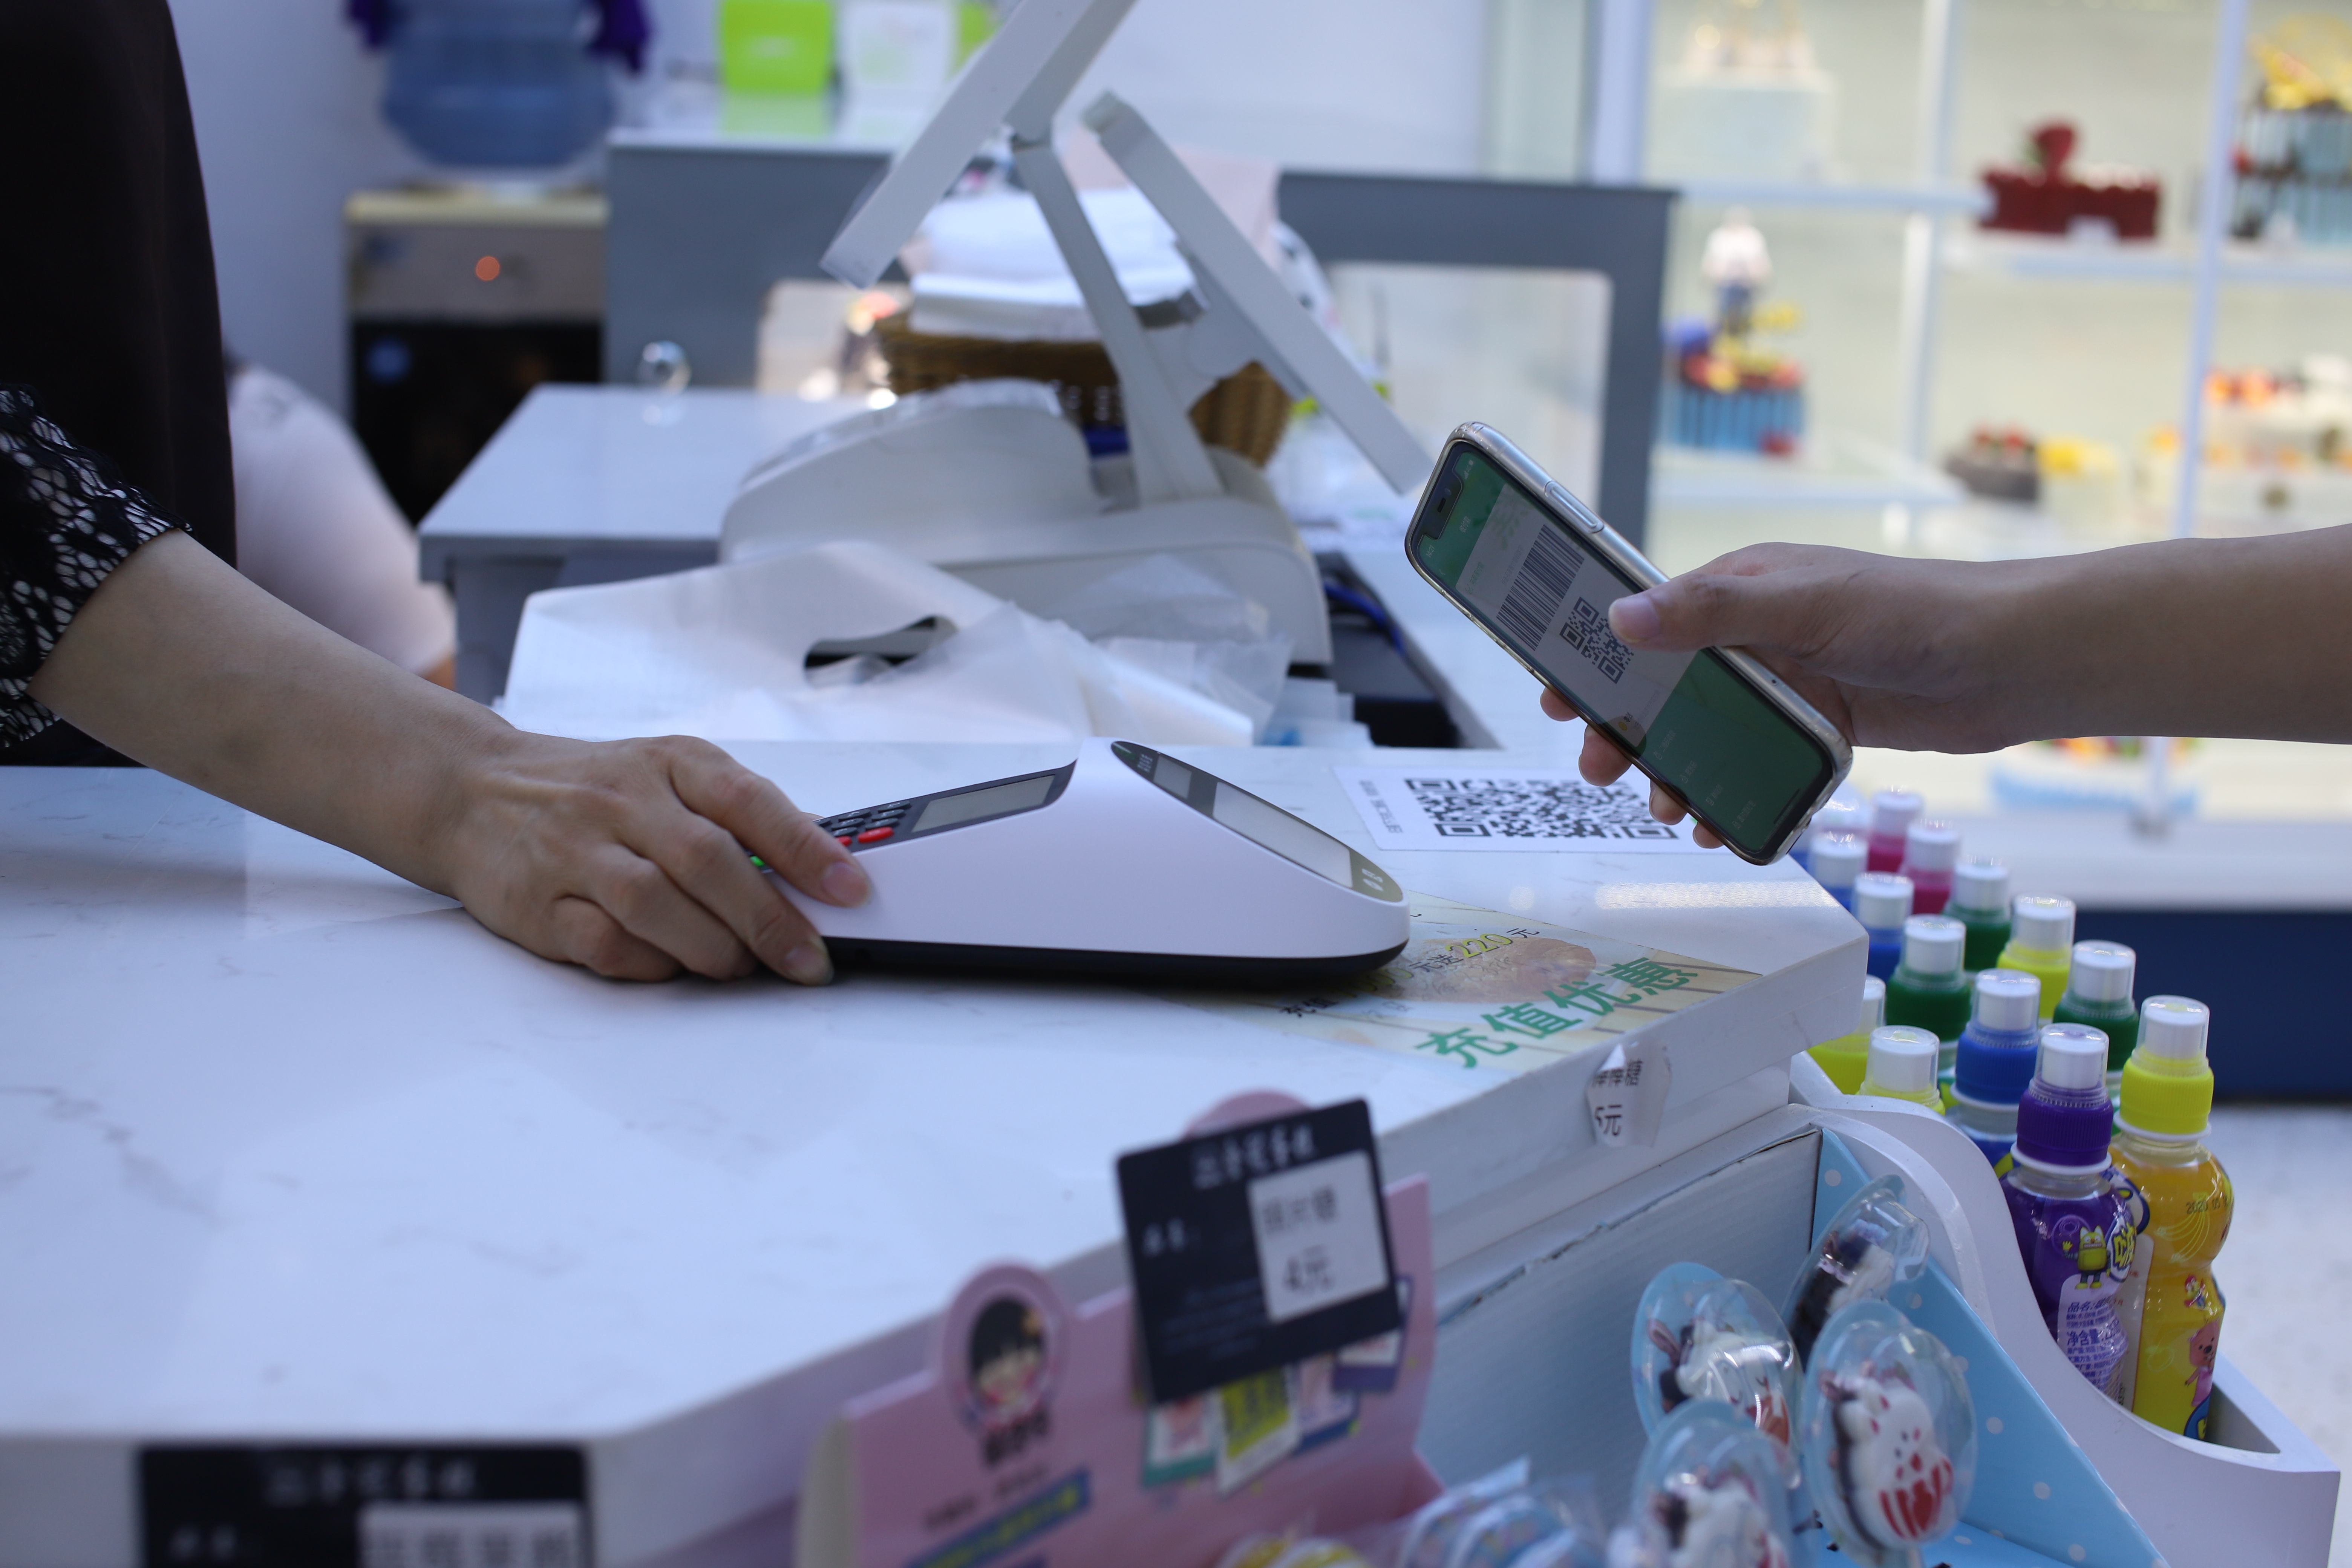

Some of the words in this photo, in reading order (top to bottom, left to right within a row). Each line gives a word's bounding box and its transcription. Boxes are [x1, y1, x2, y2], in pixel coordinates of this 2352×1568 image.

[1426, 545, 1435, 558] 14:21
[1415, 957, 1698, 1068] 充值优惠
